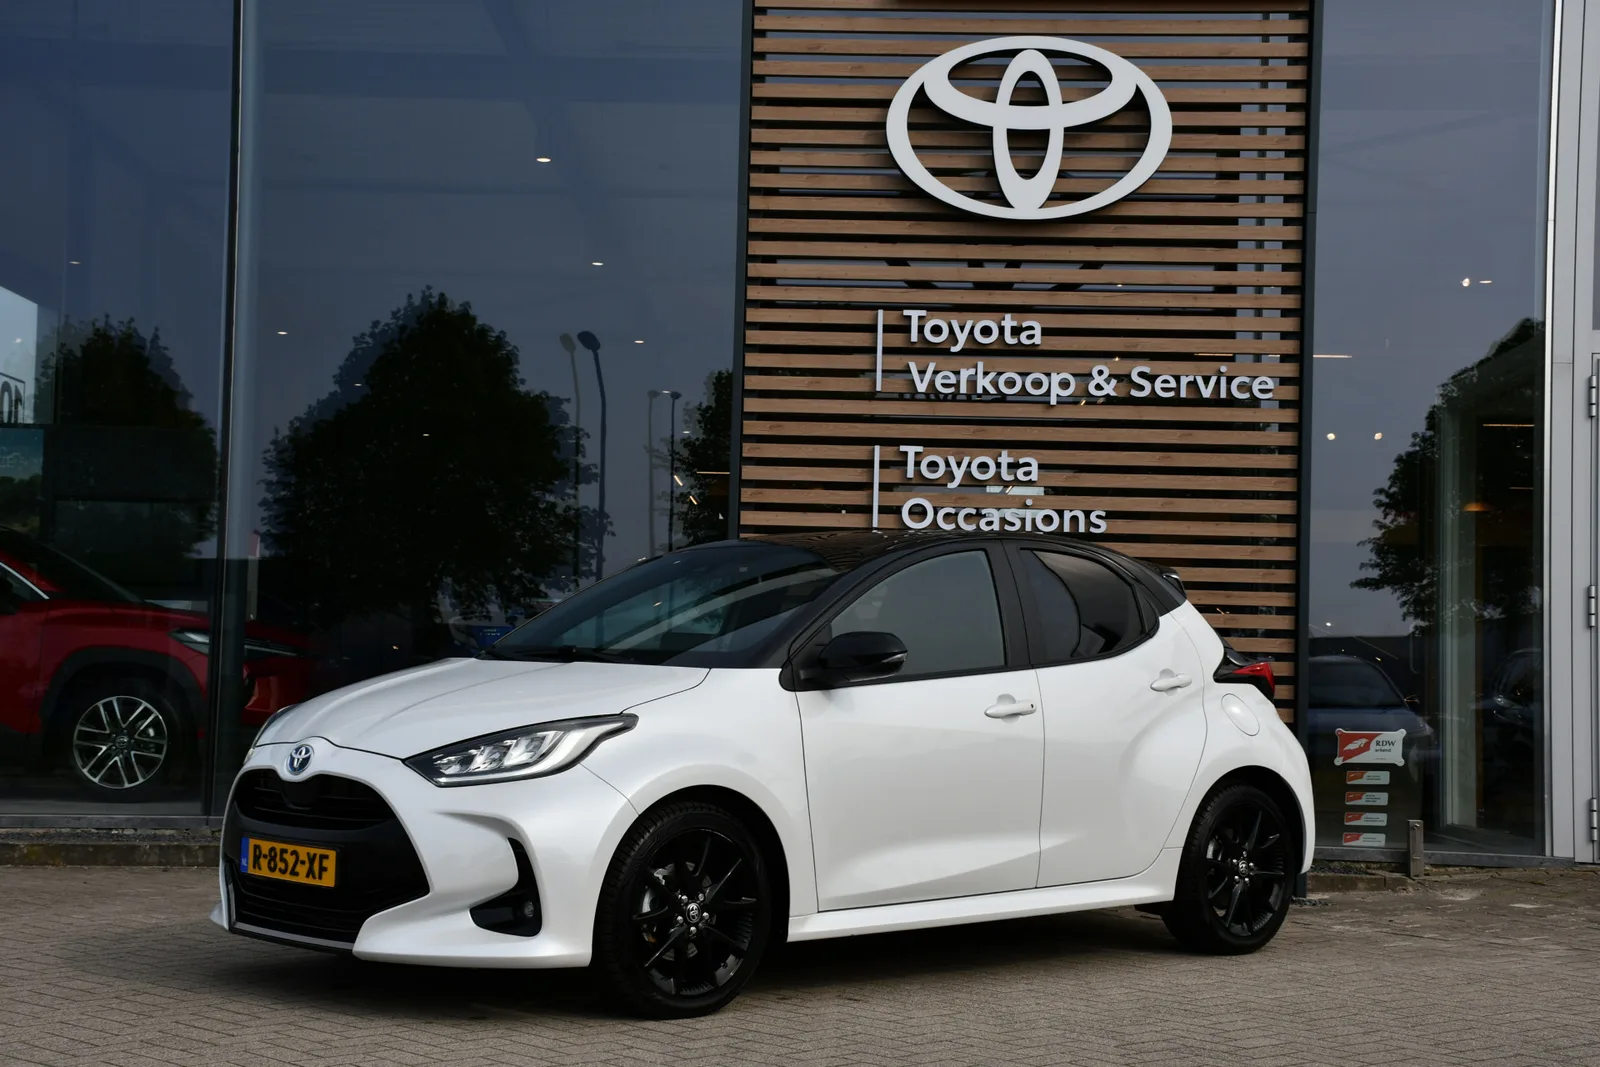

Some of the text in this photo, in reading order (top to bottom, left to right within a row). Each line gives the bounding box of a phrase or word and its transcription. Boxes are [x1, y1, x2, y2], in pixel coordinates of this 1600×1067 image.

[903, 309, 1042, 352] Toyota
[908, 361, 1275, 406] Verkoop & Service
[899, 445, 1039, 489] Toyota
[901, 497, 1108, 534] Occasions
[252, 843, 330, 880] R-852-XF
